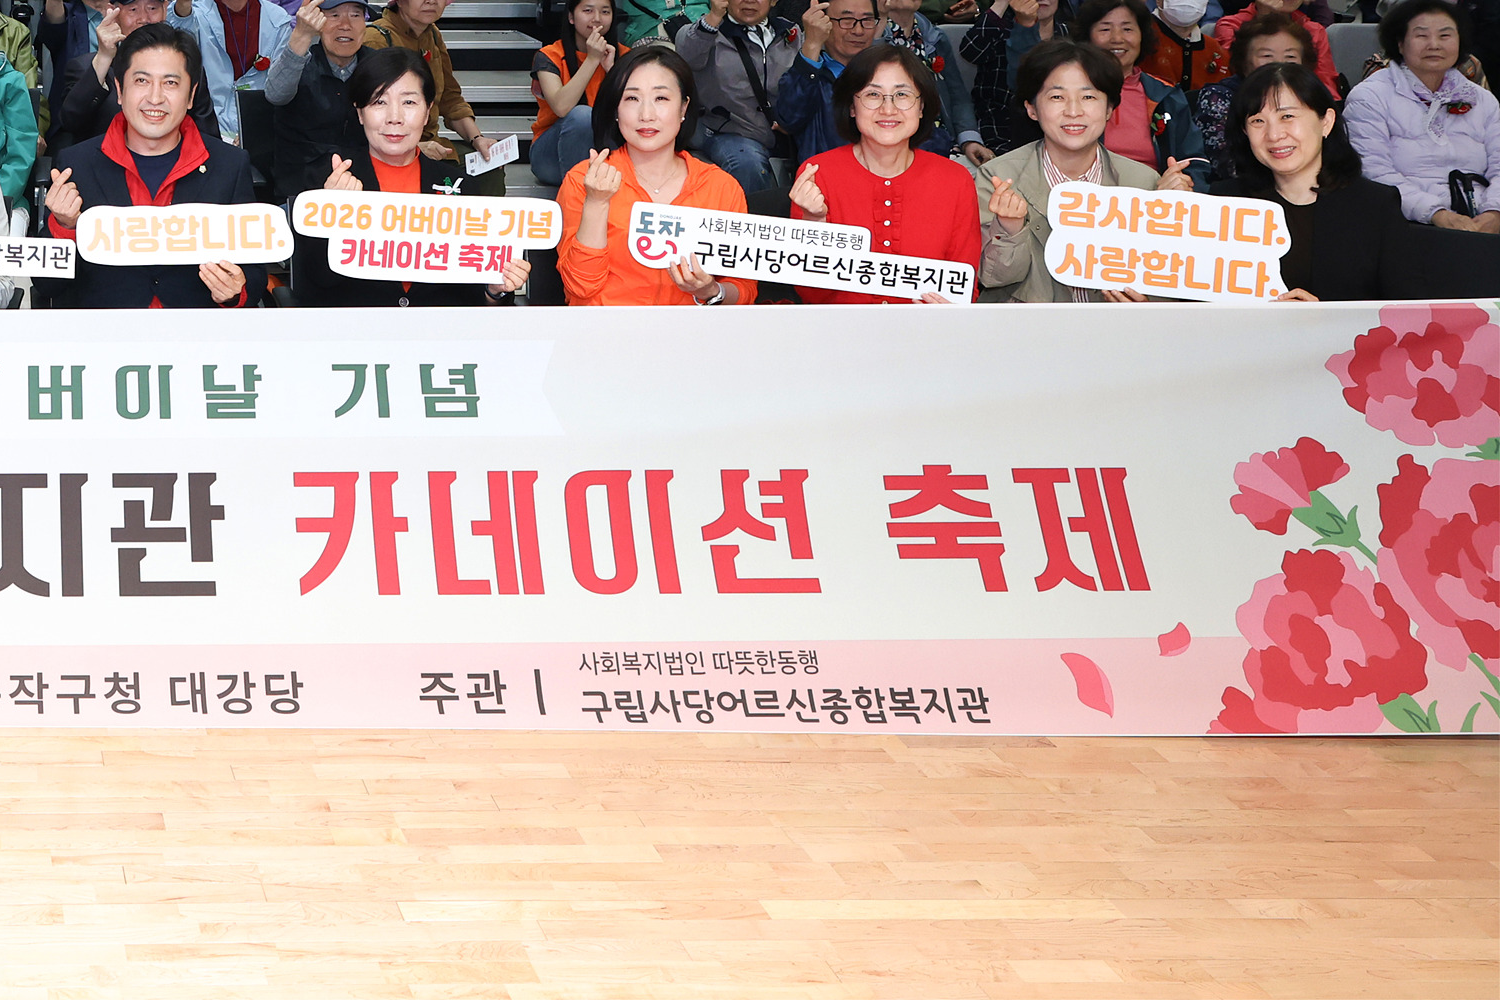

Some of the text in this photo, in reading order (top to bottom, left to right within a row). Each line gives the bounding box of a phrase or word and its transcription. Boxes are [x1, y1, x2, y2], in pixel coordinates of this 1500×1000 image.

[86, 213, 286, 253] 사랑합니다.
[303, 201, 554, 240] 2026 어버이날 기념
[699, 217, 864, 249] 사회복지법인 따뜻한동행
[1058, 190, 1286, 247] 감사합니다.
[340, 238, 513, 274] 카네이션 축제
[693, 241, 969, 296] 구립사당어르신종합복지관
[1054, 242, 1280, 299] 사랑합니다.
[331, 363, 481, 419] 기념
[292, 468, 823, 597] 카네이션
[882, 464, 1152, 593] 축제
[578, 649, 820, 676] 사회복지법인 따뜻한동행
[169, 670, 304, 715] 대강당
[418, 669, 507, 715] 주관
[581, 685, 992, 725] 구립사당어르신종합복지관
